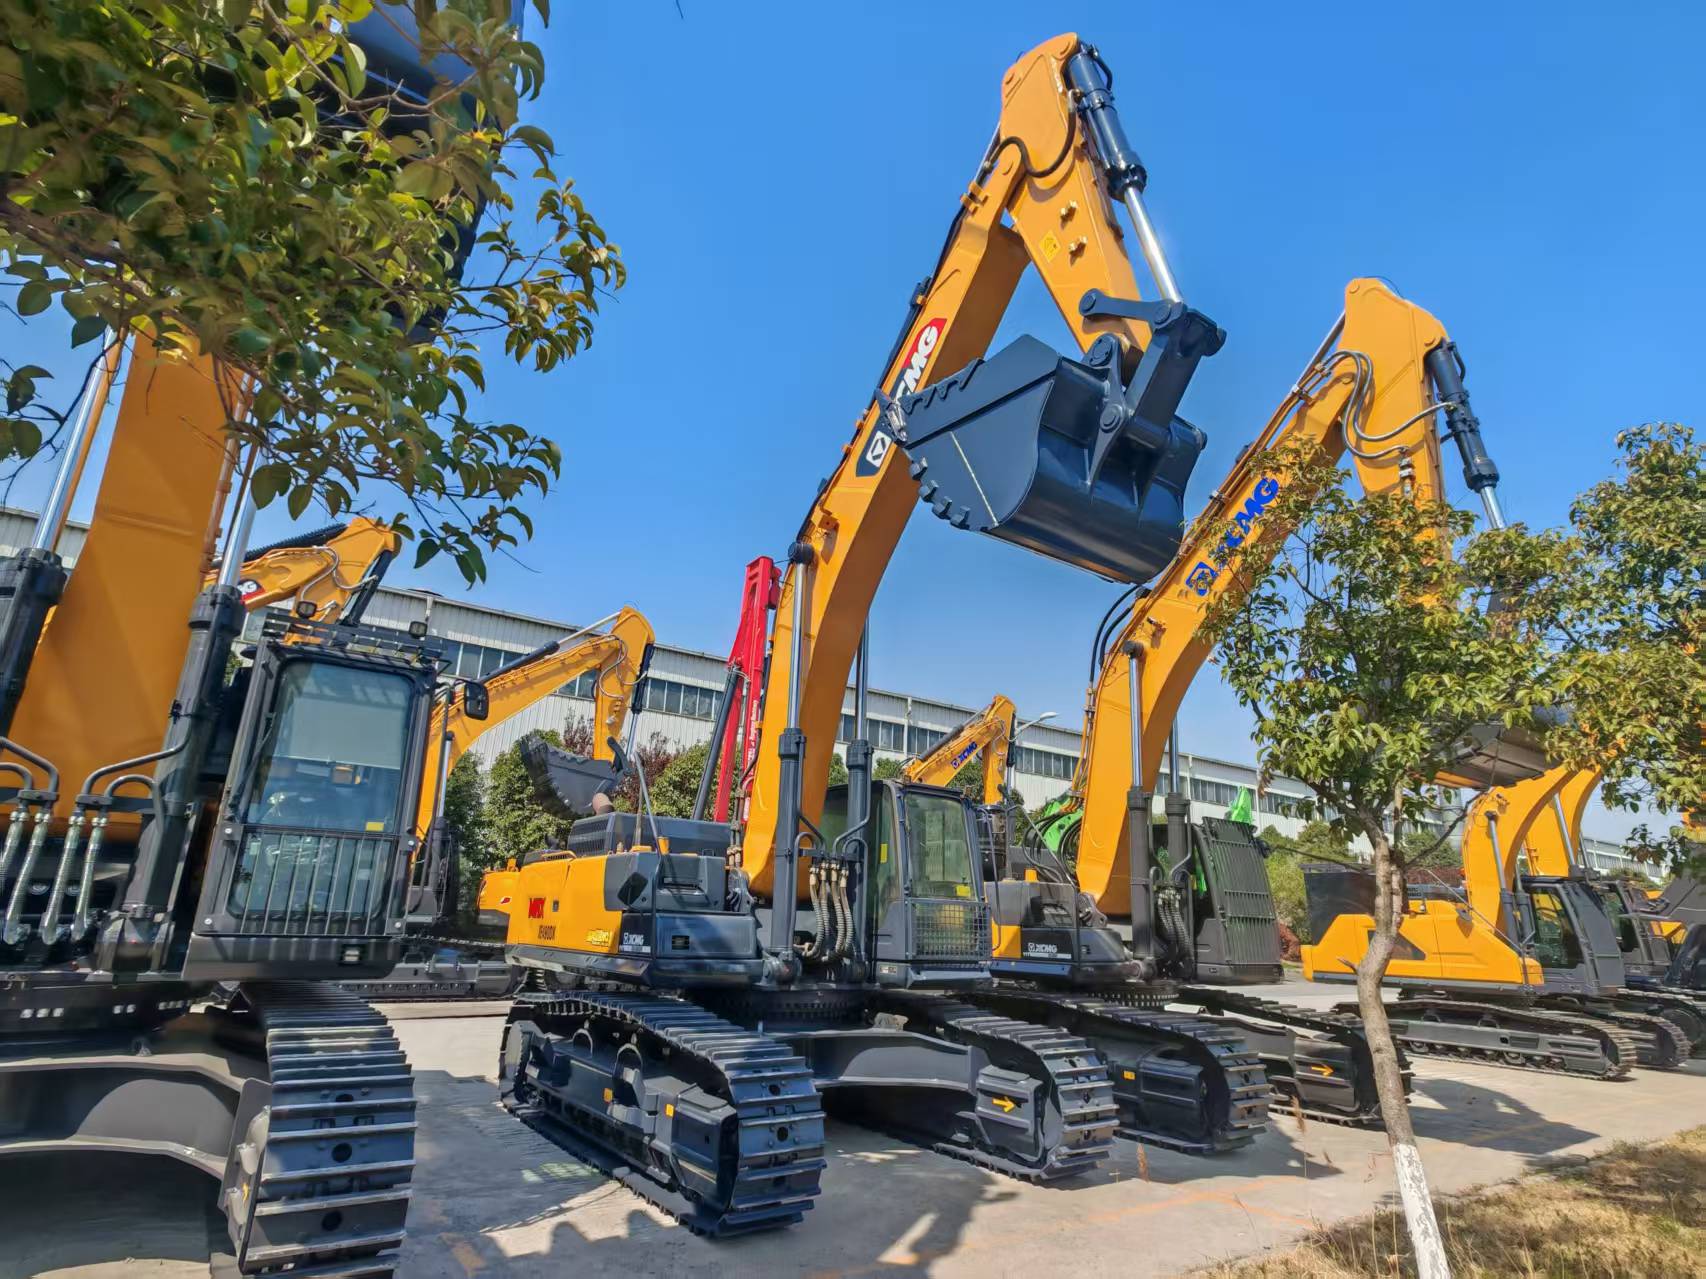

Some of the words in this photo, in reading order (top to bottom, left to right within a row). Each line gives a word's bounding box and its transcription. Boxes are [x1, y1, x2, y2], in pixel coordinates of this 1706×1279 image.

[893, 325, 940, 406] CMG
[957, 740, 978, 763] XCMG
[1035, 943, 1058, 953] XCMG
